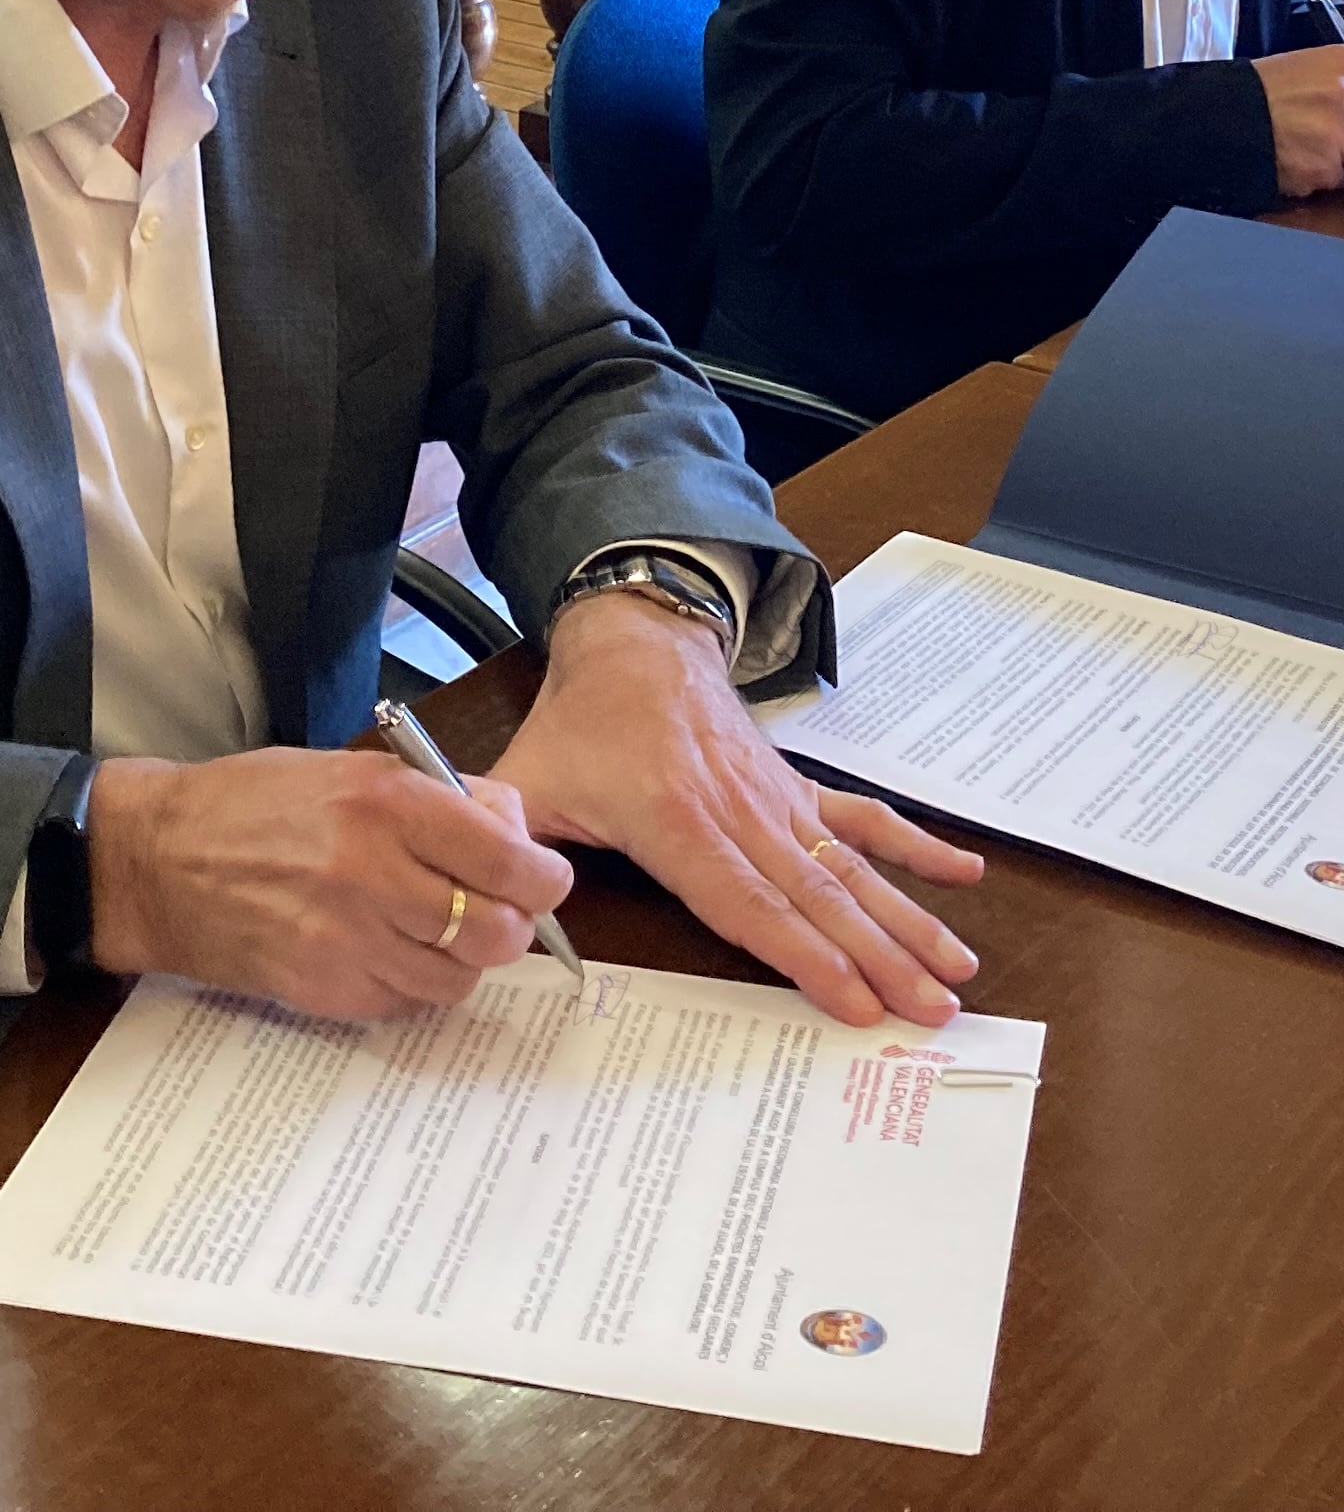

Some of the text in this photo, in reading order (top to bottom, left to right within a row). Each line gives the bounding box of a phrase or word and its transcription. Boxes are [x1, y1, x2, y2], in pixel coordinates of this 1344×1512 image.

[880, 1067, 909, 1140] VALENCIANA
[903, 1068, 932, 1145] GENERALITAT
[764, 1268, 793, 1330] Ajuntament
